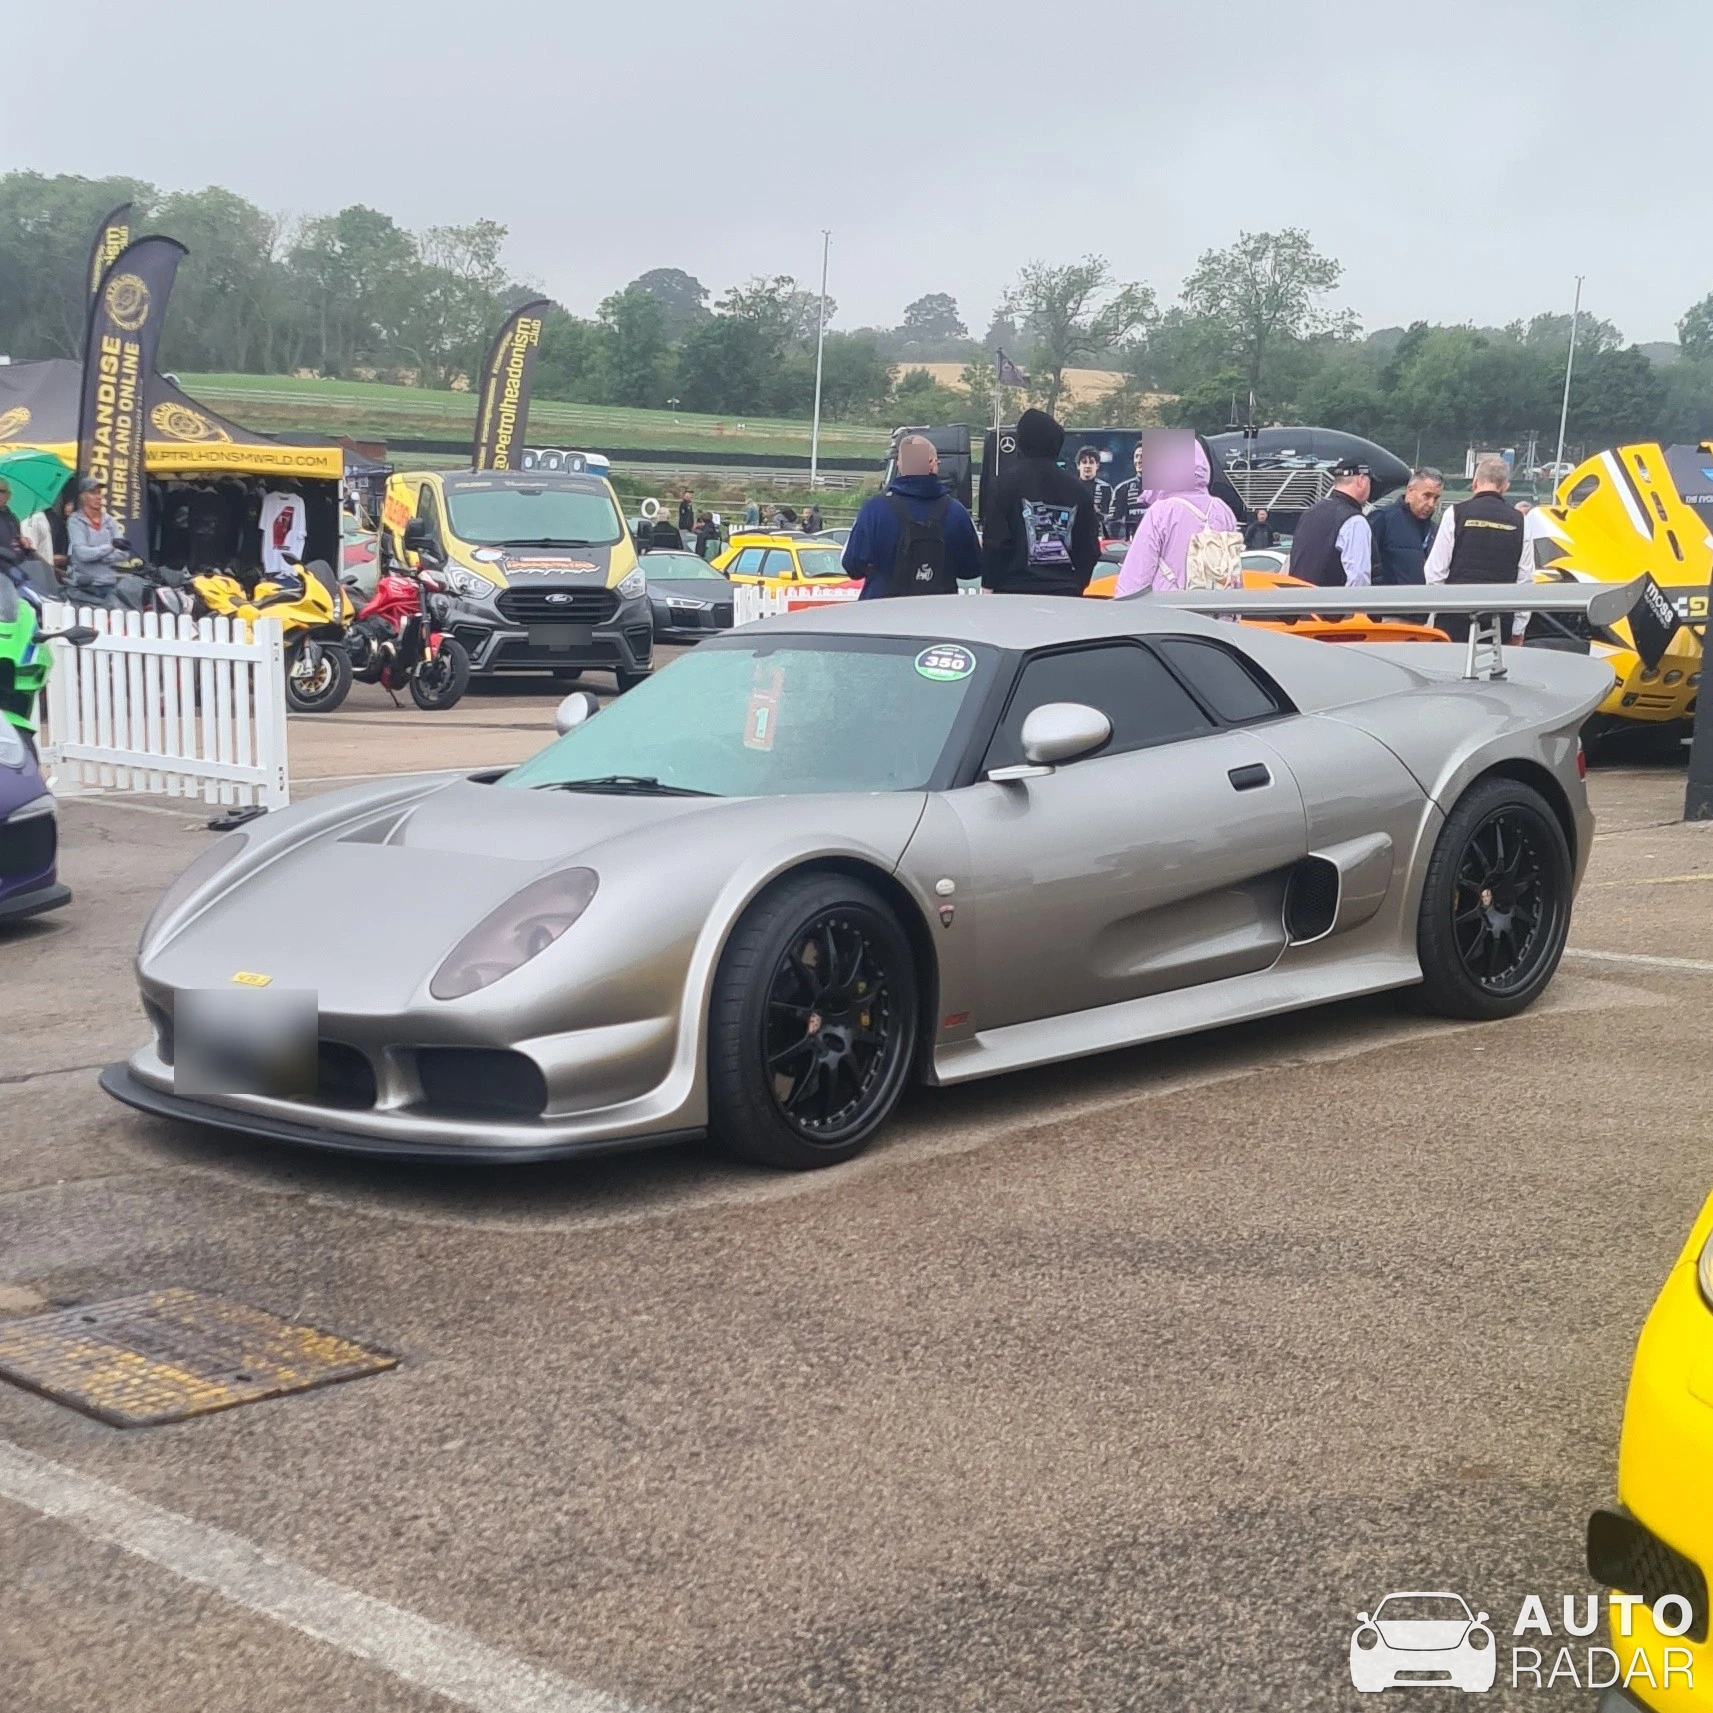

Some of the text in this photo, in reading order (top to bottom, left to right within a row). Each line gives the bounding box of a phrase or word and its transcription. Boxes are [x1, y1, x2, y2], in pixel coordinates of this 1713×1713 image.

[118, 341, 140, 412] ONLINE
[493, 317, 531, 470] @Petrolheadonism
[89, 335, 121, 513] CHANDISE
[114, 415, 132, 455] AND
[144, 450, 328, 467] W.PTRLHDNSMWRLD.COM
[111, 457, 129, 508] HERE
[925, 655, 965, 670] 350
[756, 707, 770, 739] 1
